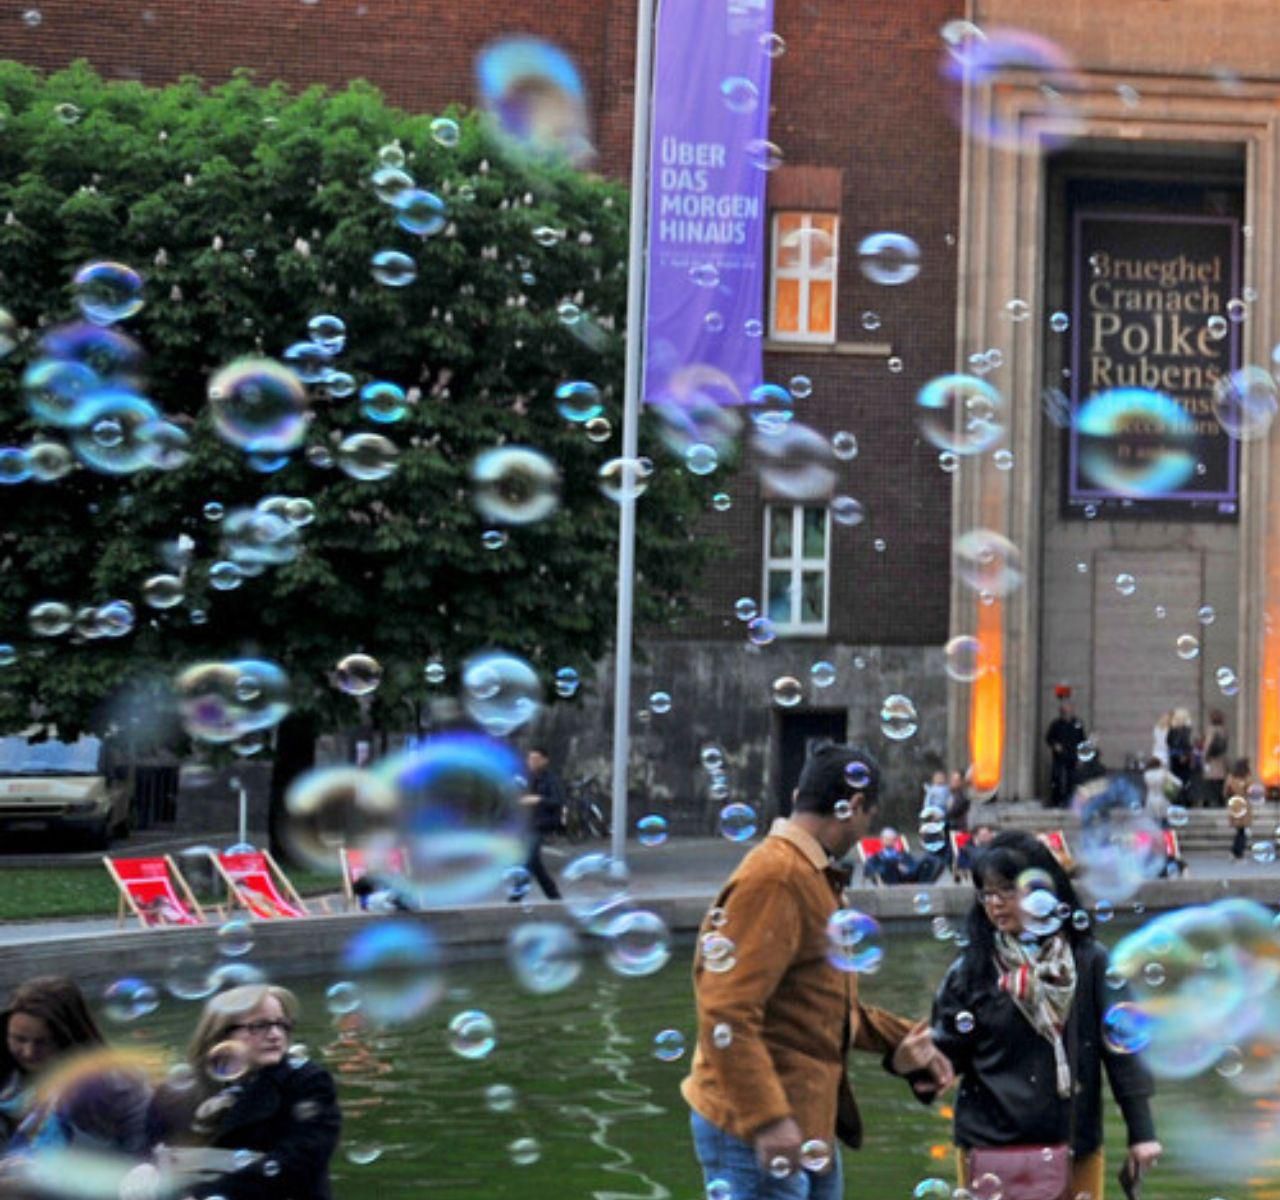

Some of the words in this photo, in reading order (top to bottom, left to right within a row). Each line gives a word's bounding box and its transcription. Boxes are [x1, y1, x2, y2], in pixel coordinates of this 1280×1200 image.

[662, 136, 726, 168] ÜBER
[662, 168, 708, 192] DAS
[661, 194, 758, 219] MORGEN
[660, 219, 746, 244] HINAUS
[1091, 252, 1221, 287] Brueghel
[1090, 279, 1219, 313] Cranach
[1093, 312, 1221, 357] Polke
[1090, 355, 1221, 390] Rubens
